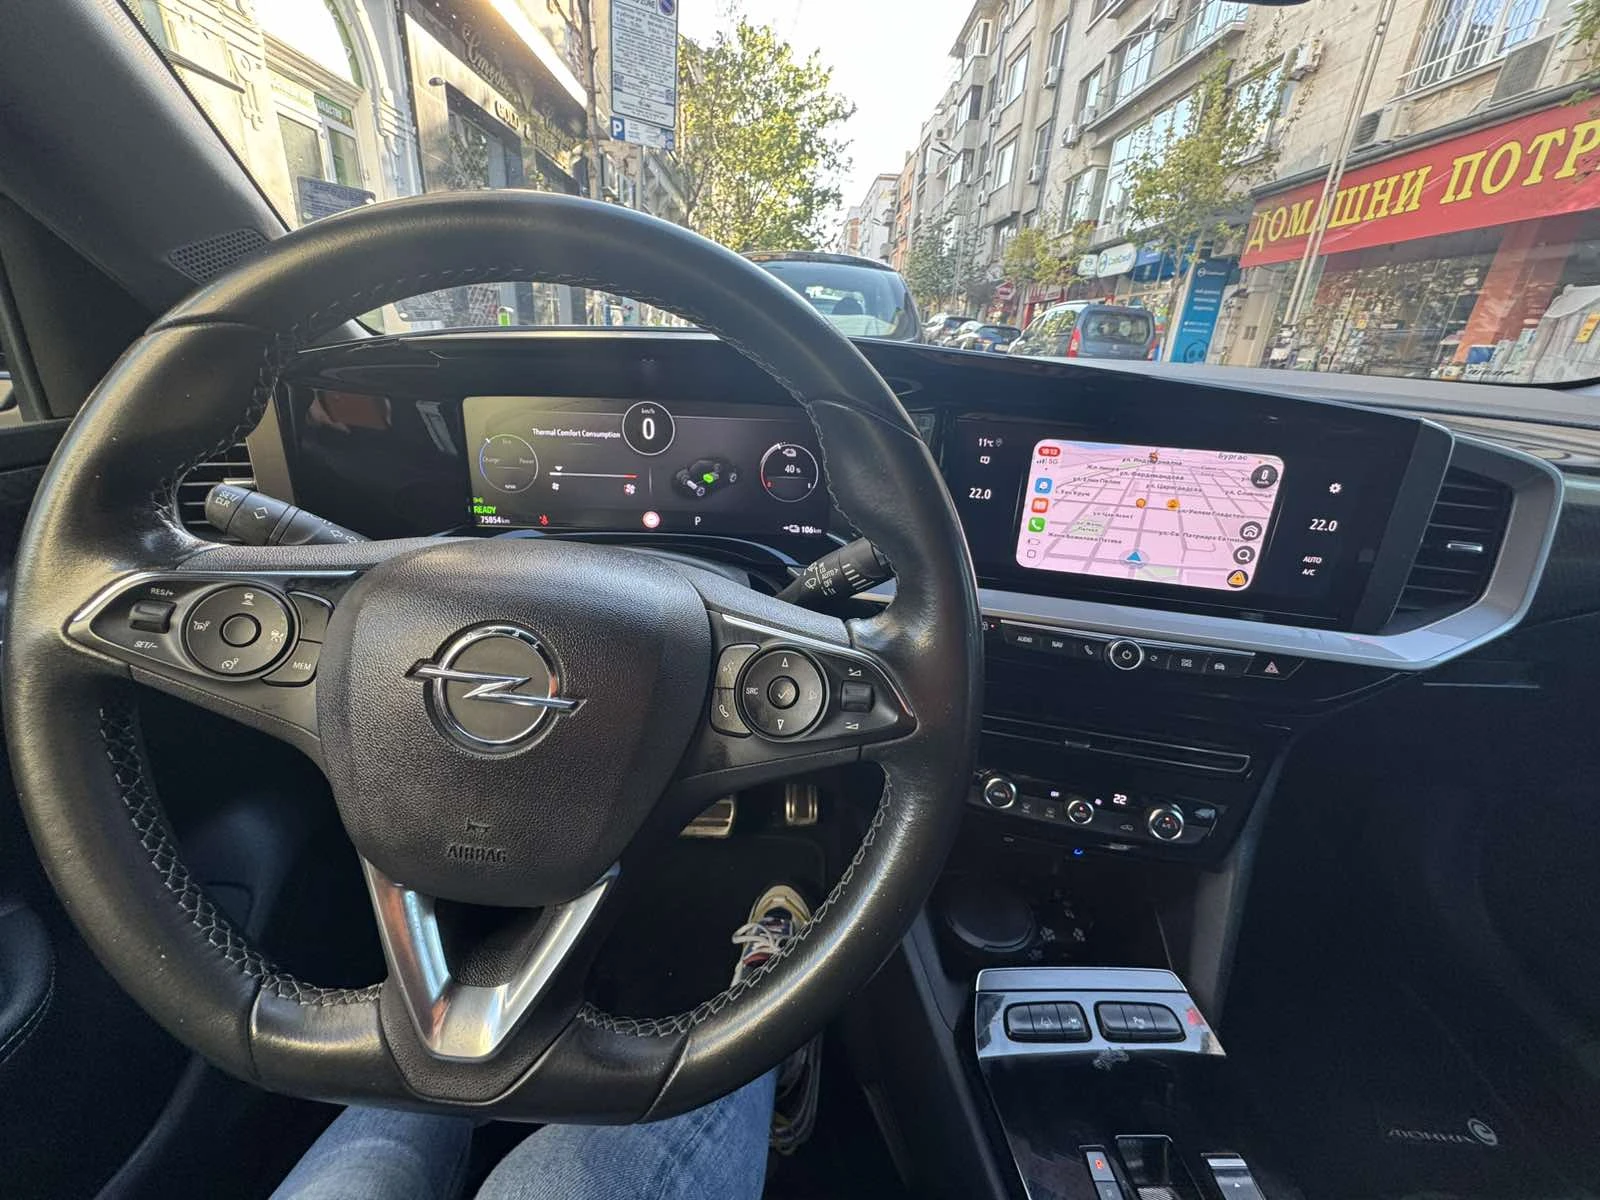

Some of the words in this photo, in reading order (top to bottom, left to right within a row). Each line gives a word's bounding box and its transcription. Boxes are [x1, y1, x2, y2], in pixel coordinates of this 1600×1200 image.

[612, 120, 624, 137] P
[532, 427, 557, 437] Thermal
[556, 429, 581, 438] Comfort
[581, 429, 621, 440] Consumption
[642, 417, 655, 440] 0
[784, 464, 796, 474] 40
[1261, 469, 1269, 480] 0
[968, 487, 992, 501] 22.0
[473, 505, 497, 515] READY
[694, 516, 702, 526] P
[1308, 518, 1339, 532] 22.0
[1302, 555, 1323, 565] AUTO
[1301, 567, 1317, 577] A/C
[292, 661, 312, 672] MEM
[745, 687, 759, 696] SRC
[1113, 793, 1128, 805] 22
[446, 844, 507, 863] AIRBAG
